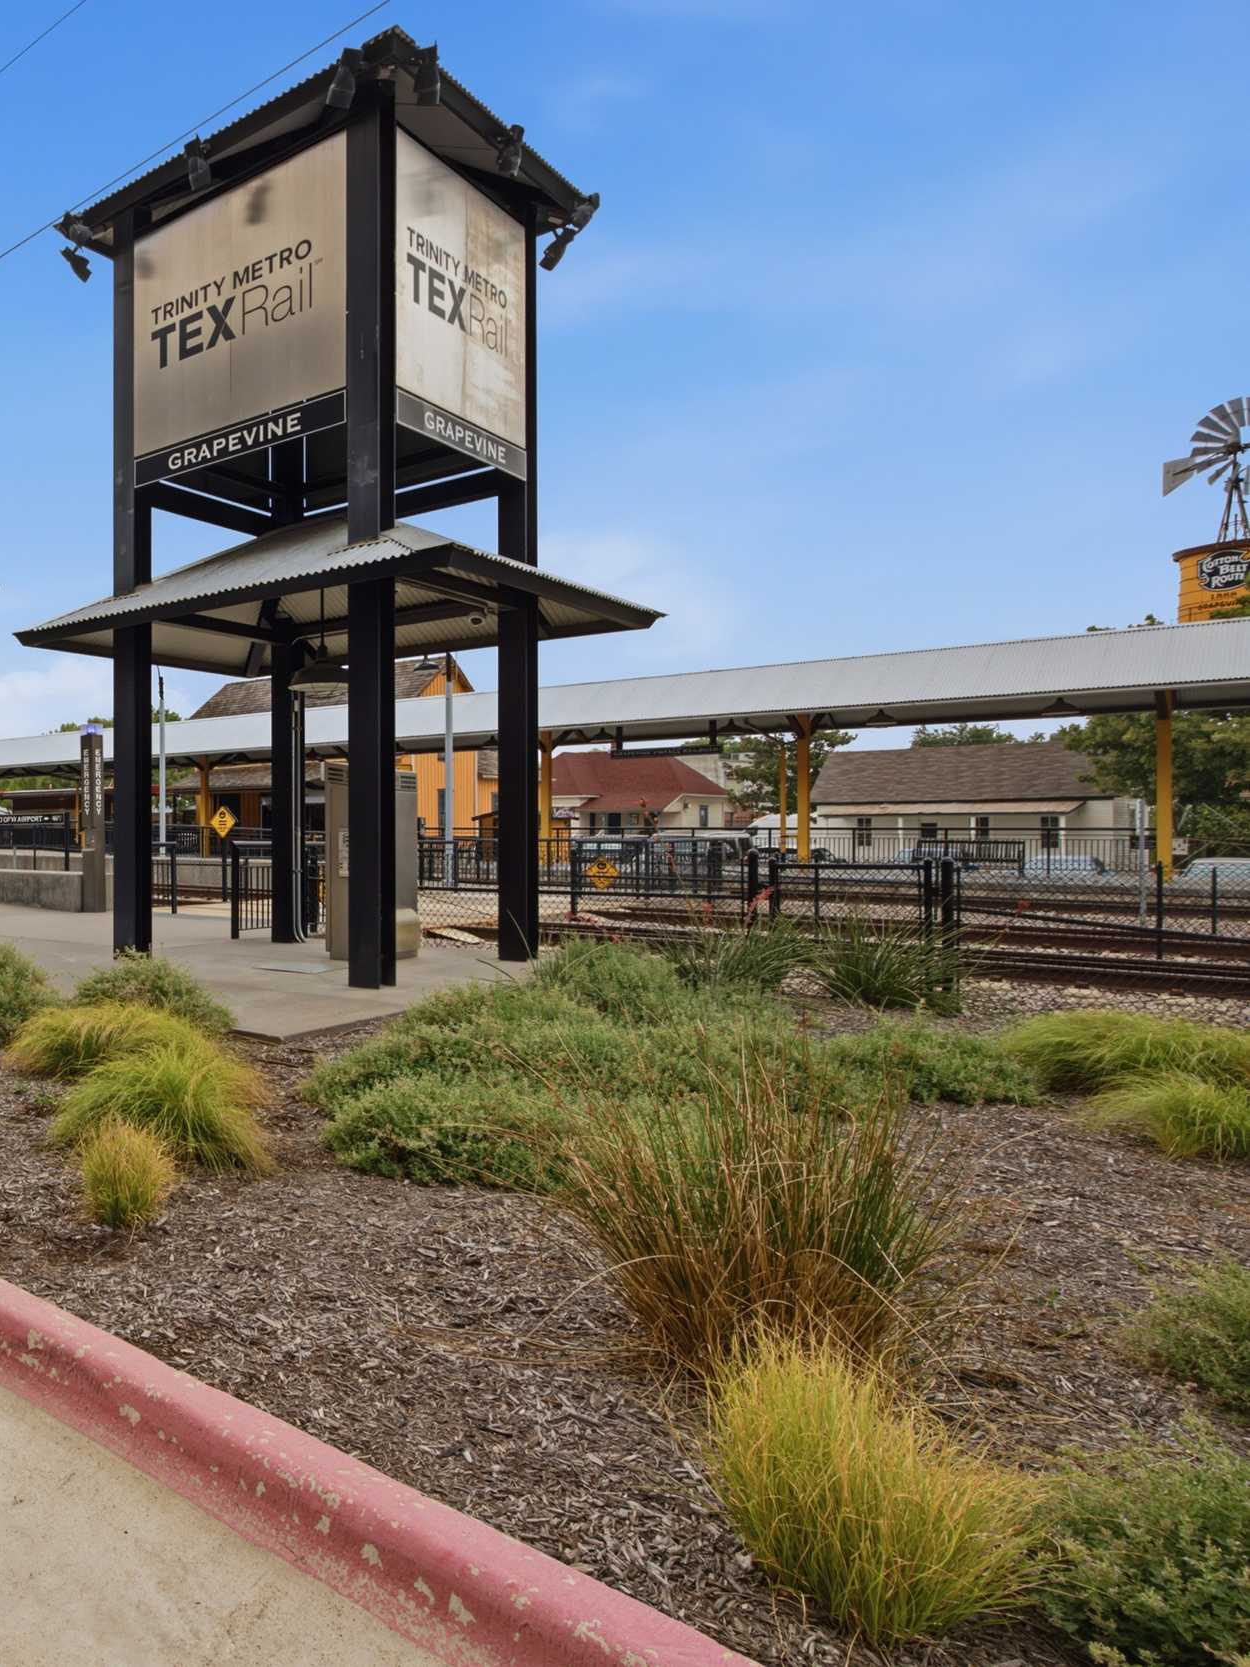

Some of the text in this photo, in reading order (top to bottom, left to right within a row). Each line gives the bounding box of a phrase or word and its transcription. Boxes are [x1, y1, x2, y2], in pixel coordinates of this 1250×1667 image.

[151, 239, 313, 325] TRINITY METRO
[406, 226, 508, 309] TRINITY METRO
[167, 411, 302, 470] GRAPEVINE
[424, 411, 507, 464] GRAPEVINE
[1217, 563, 1249, 575] BELT
